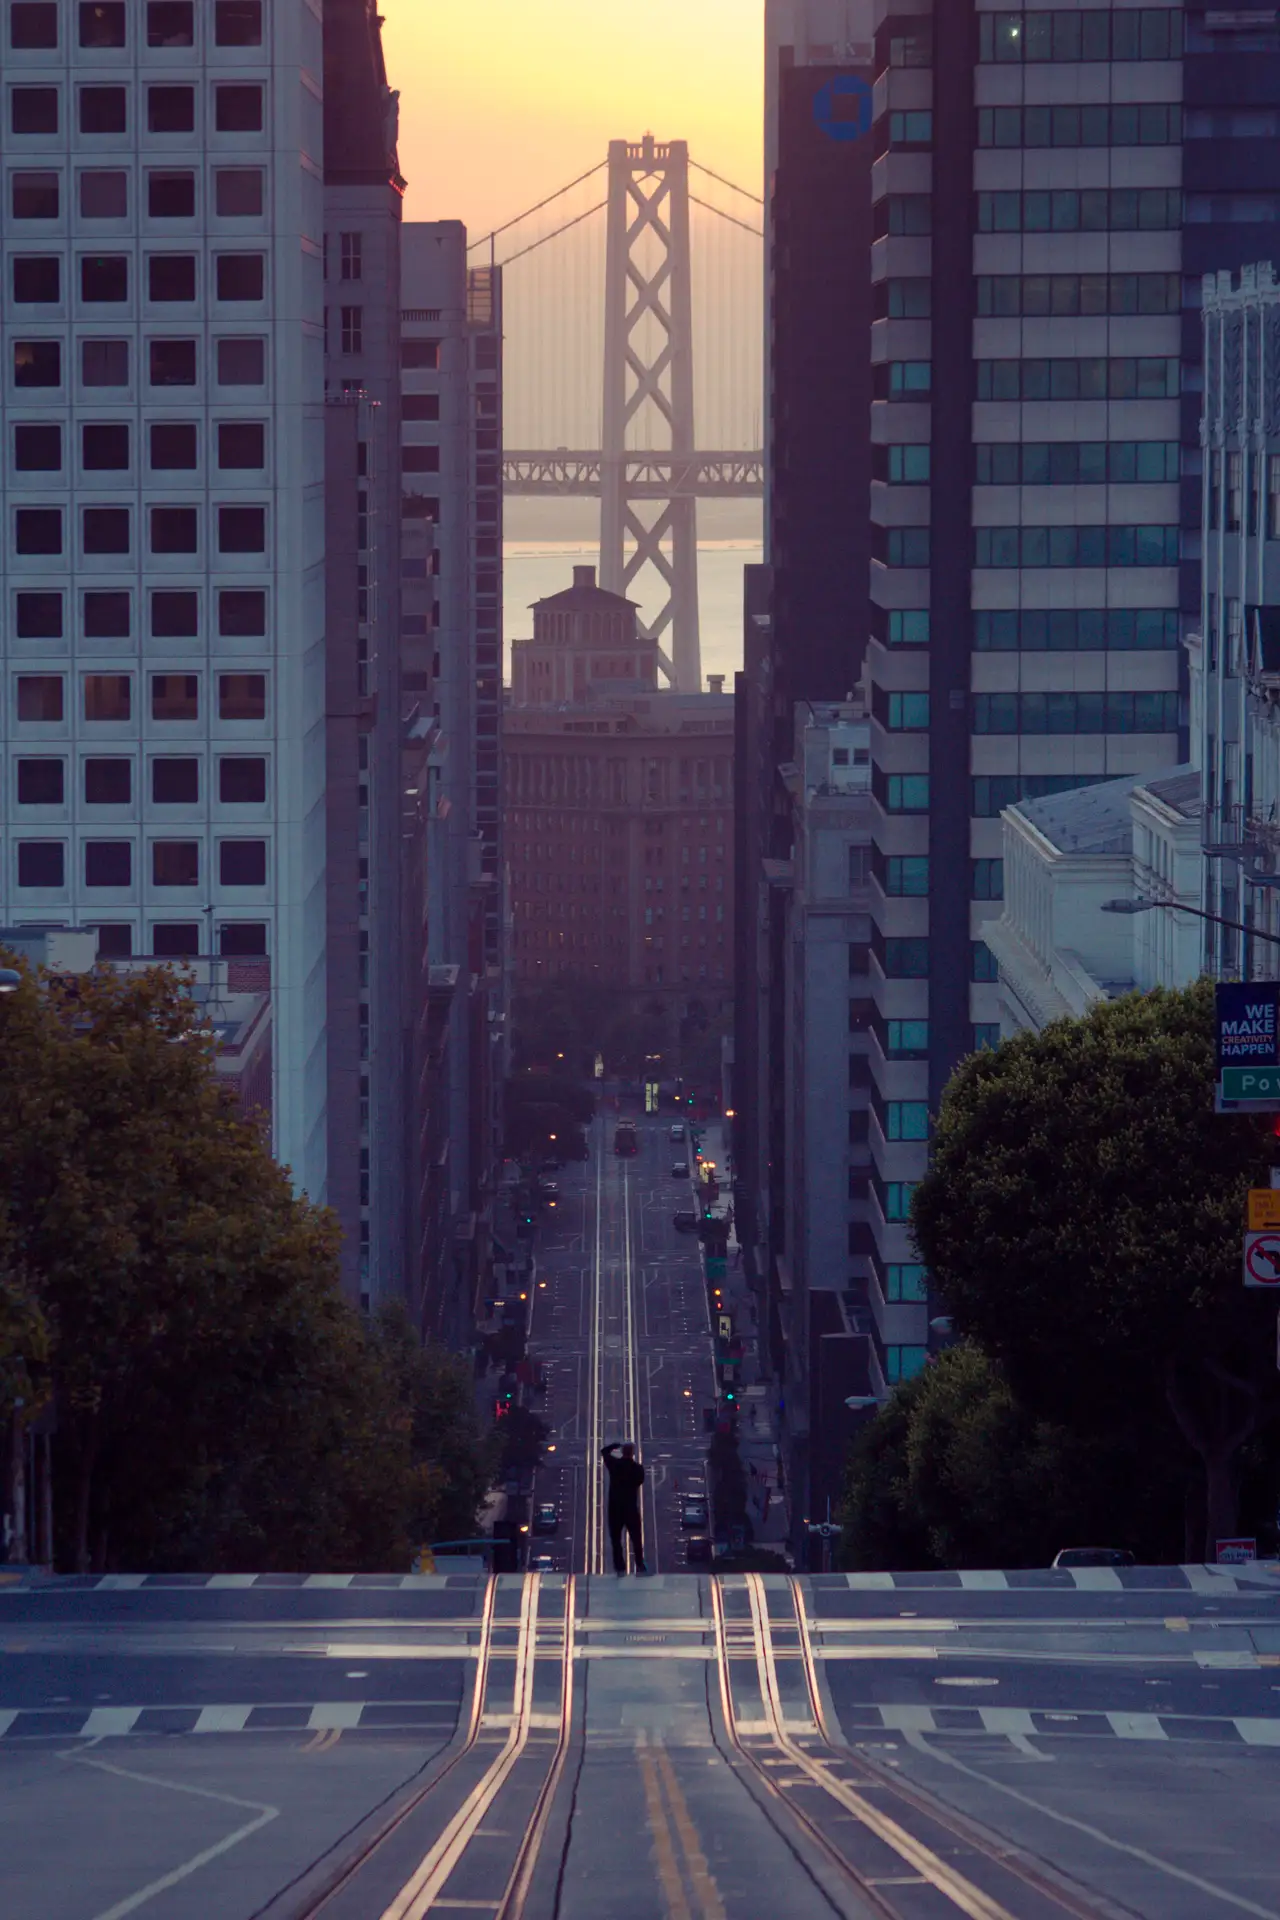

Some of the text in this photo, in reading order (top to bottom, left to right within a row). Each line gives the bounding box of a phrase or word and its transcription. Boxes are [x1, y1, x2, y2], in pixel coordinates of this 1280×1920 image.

[1245, 1004, 1275, 1019] WE
[1221, 1020, 1275, 1035] MAKE
[1222, 1035, 1274, 1044] CREATIVITY
[1221, 1044, 1275, 1056] HAPPEN
[1242, 1075, 1280, 1091] Po
